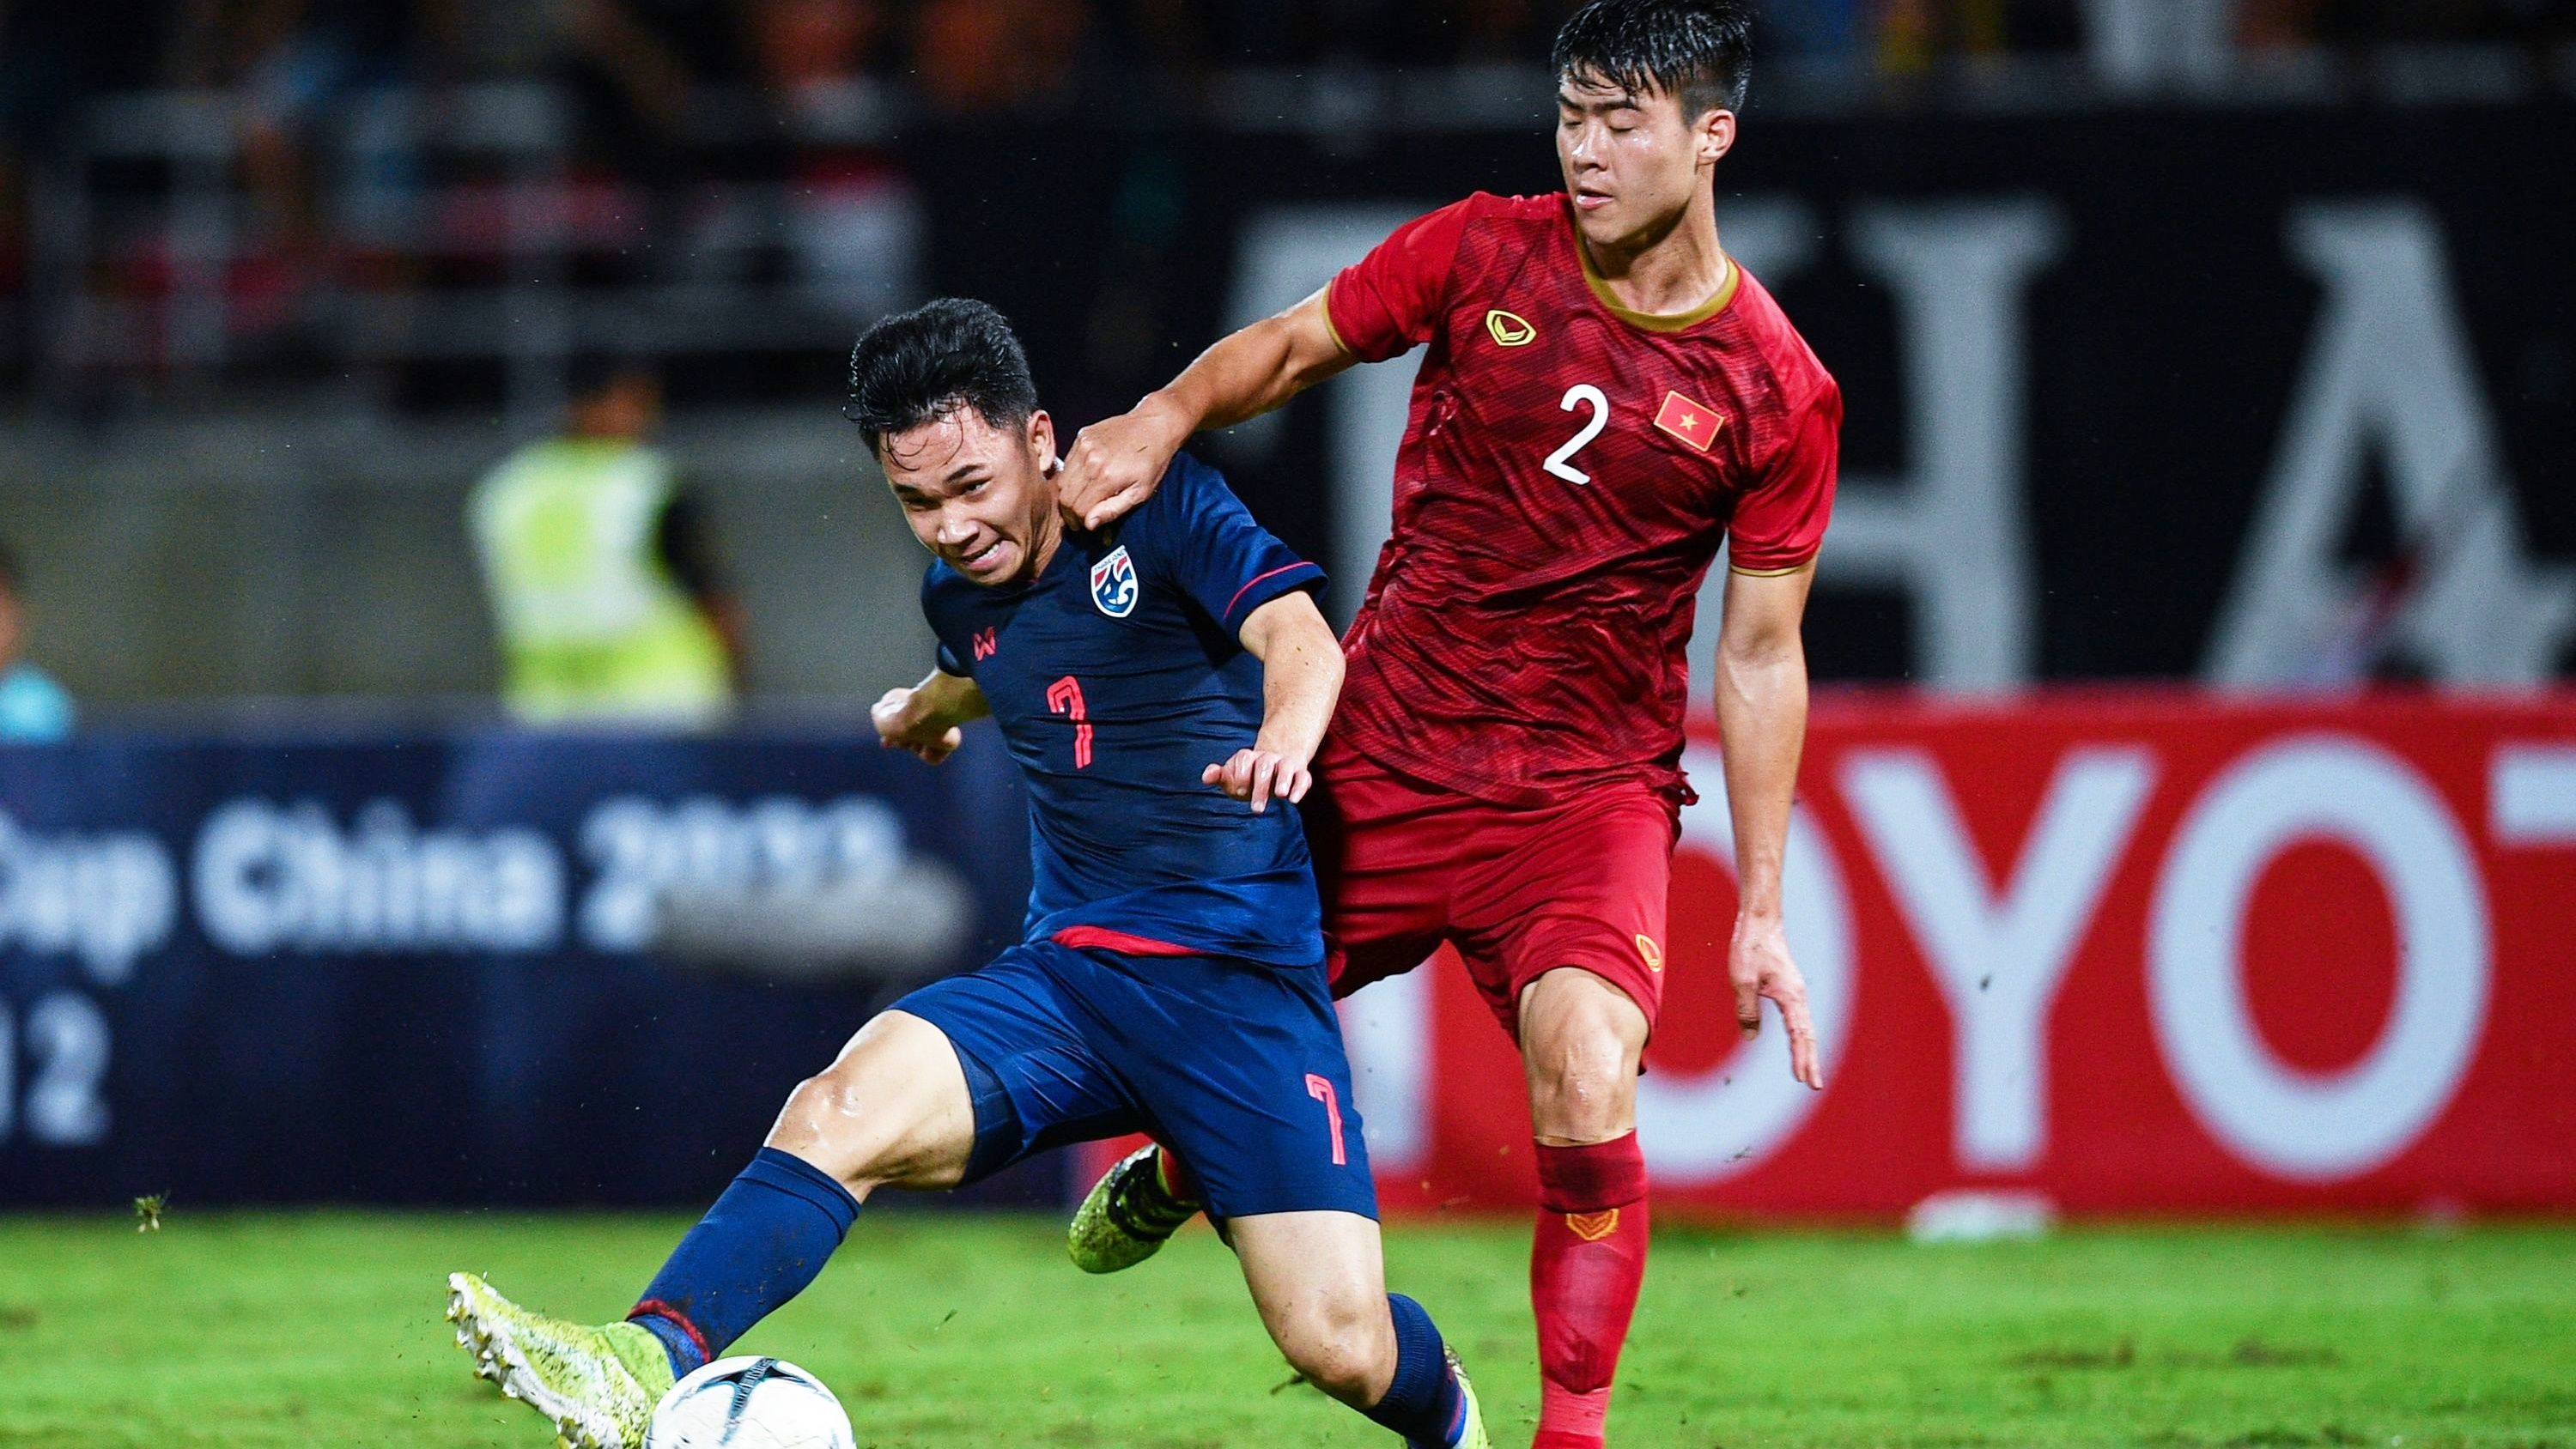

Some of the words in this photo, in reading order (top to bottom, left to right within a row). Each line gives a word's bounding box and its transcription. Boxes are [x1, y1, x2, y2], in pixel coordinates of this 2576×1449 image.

[1542, 384, 1609, 486] 2
[1047, 675, 1094, 769] 7
[191, 797, 564, 953] China
[1305, 1073, 1346, 1166] 7
